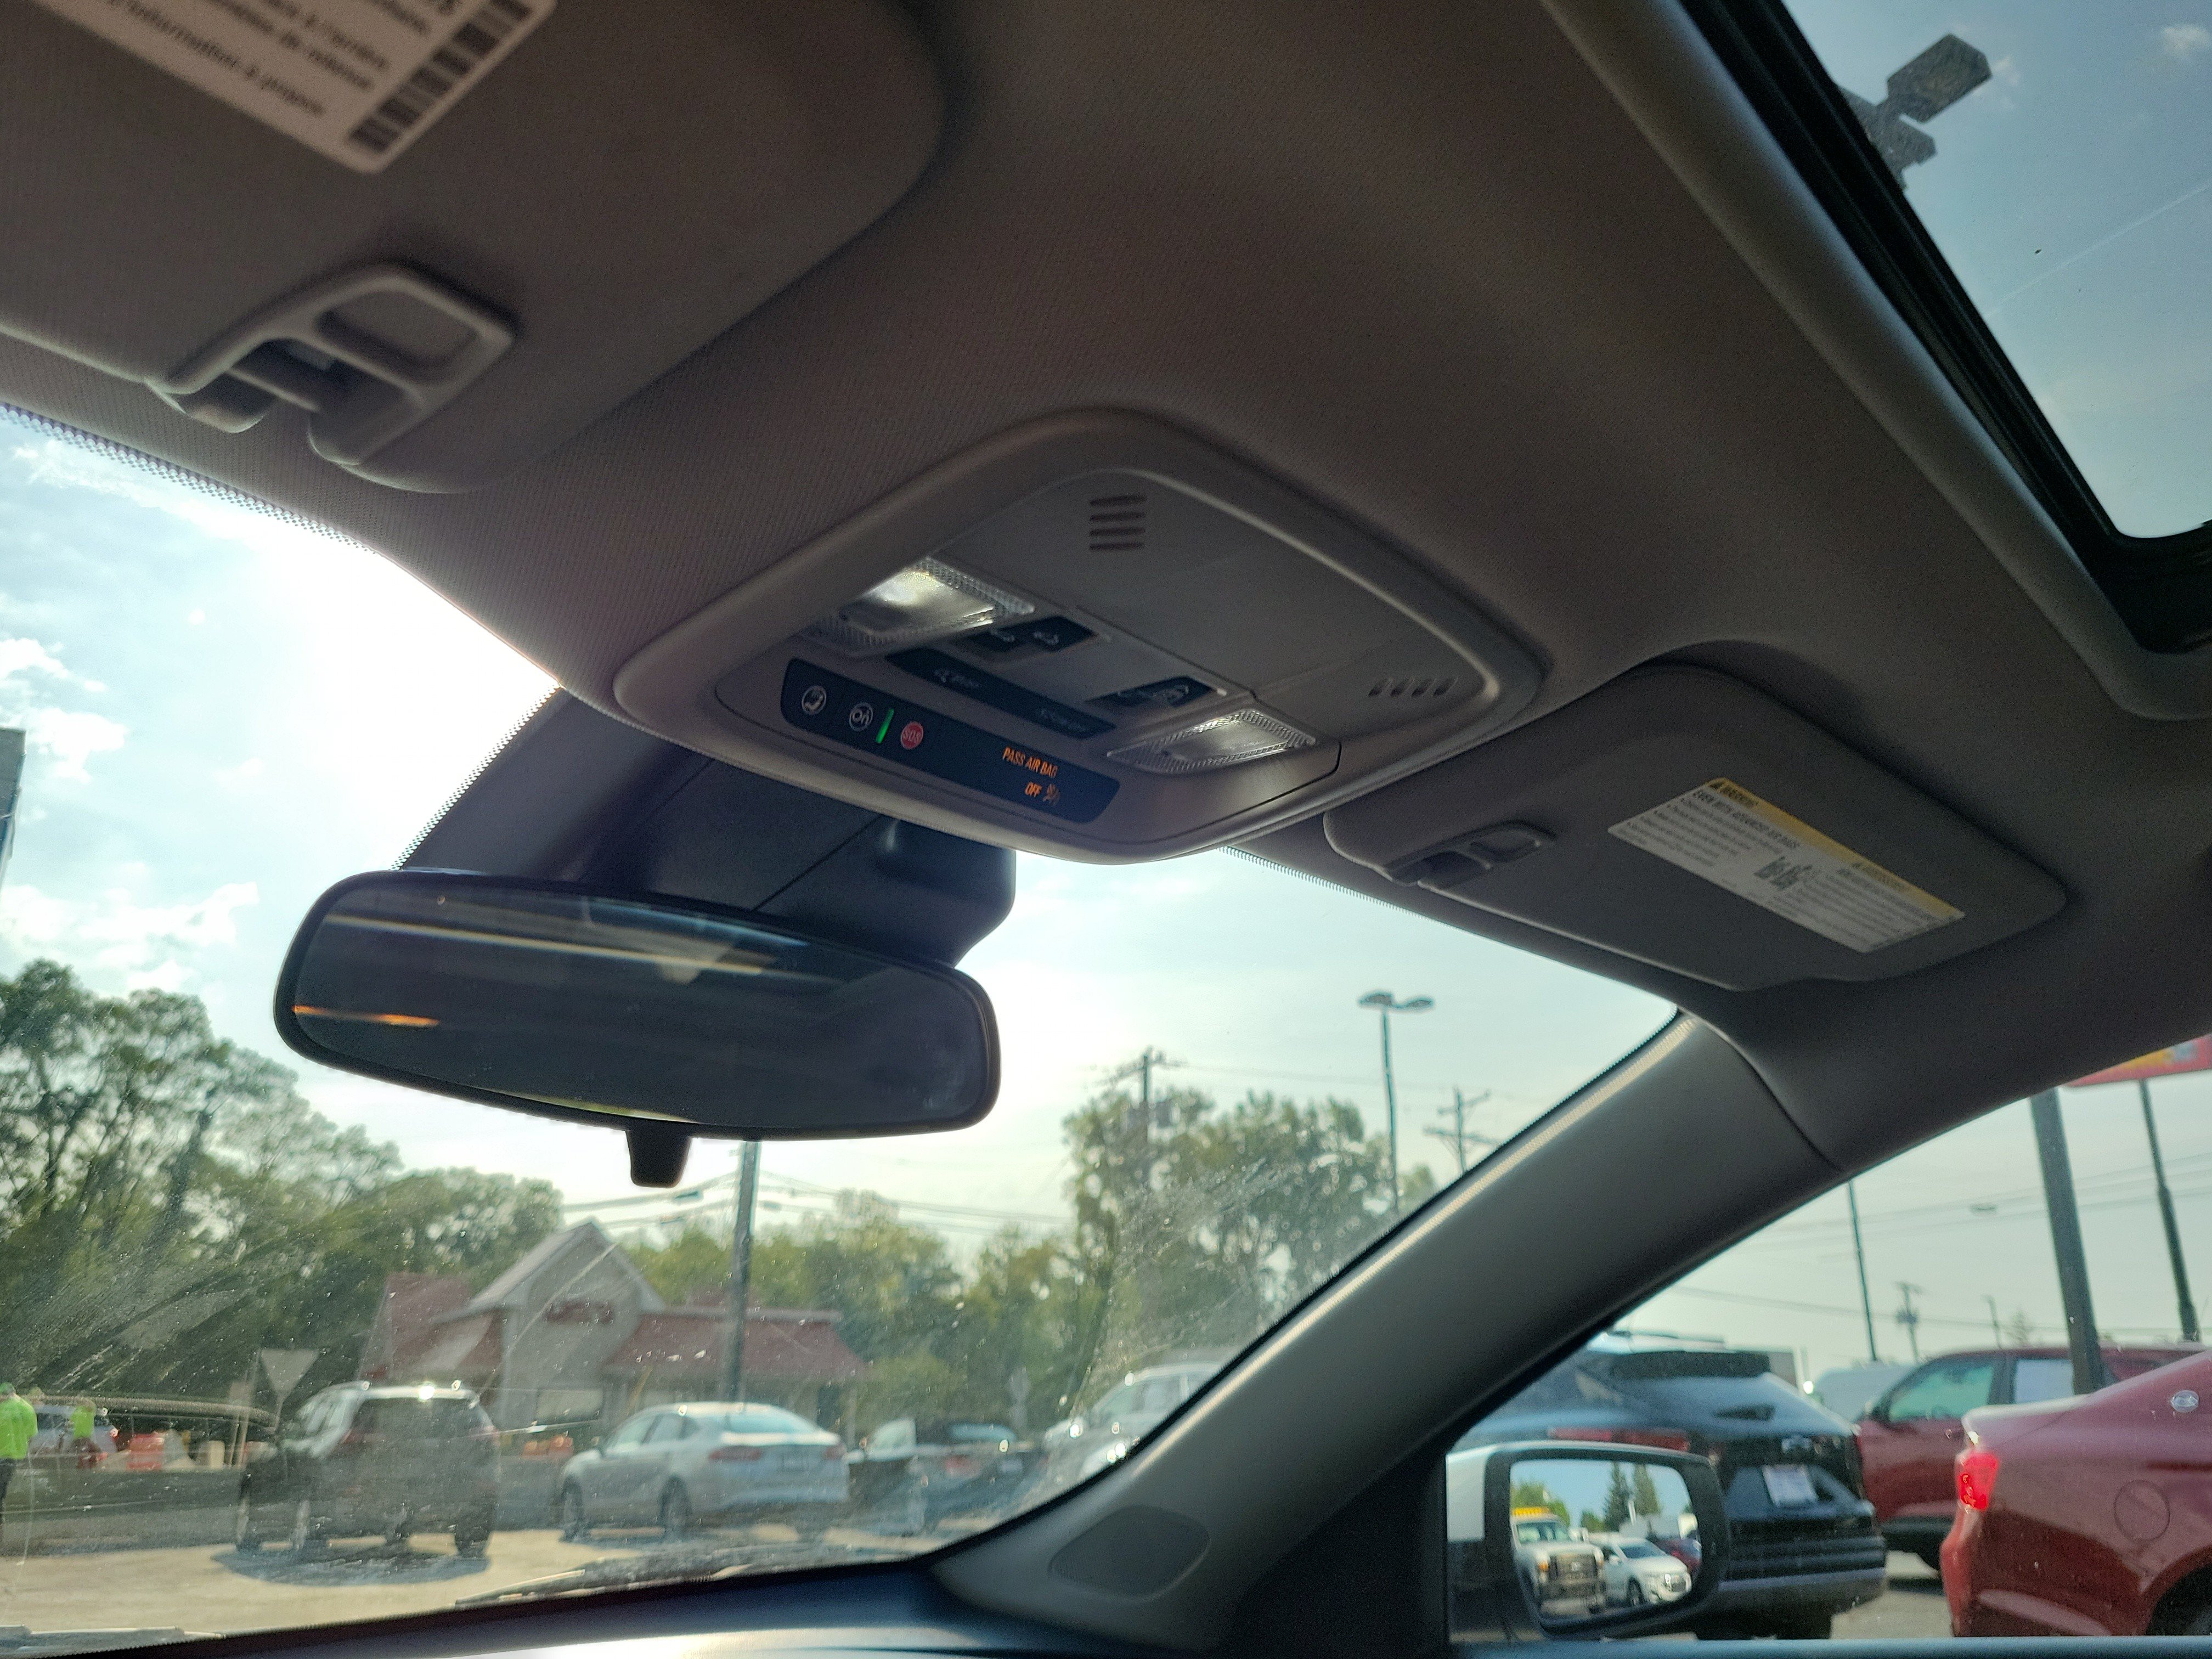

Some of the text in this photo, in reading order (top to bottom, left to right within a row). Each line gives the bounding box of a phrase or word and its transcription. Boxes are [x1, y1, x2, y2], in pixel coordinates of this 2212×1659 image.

[904, 729, 922, 744] SOS
[1002, 747, 1059, 779] PASS AIR BAG
[1025, 781, 1043, 798] OFF
